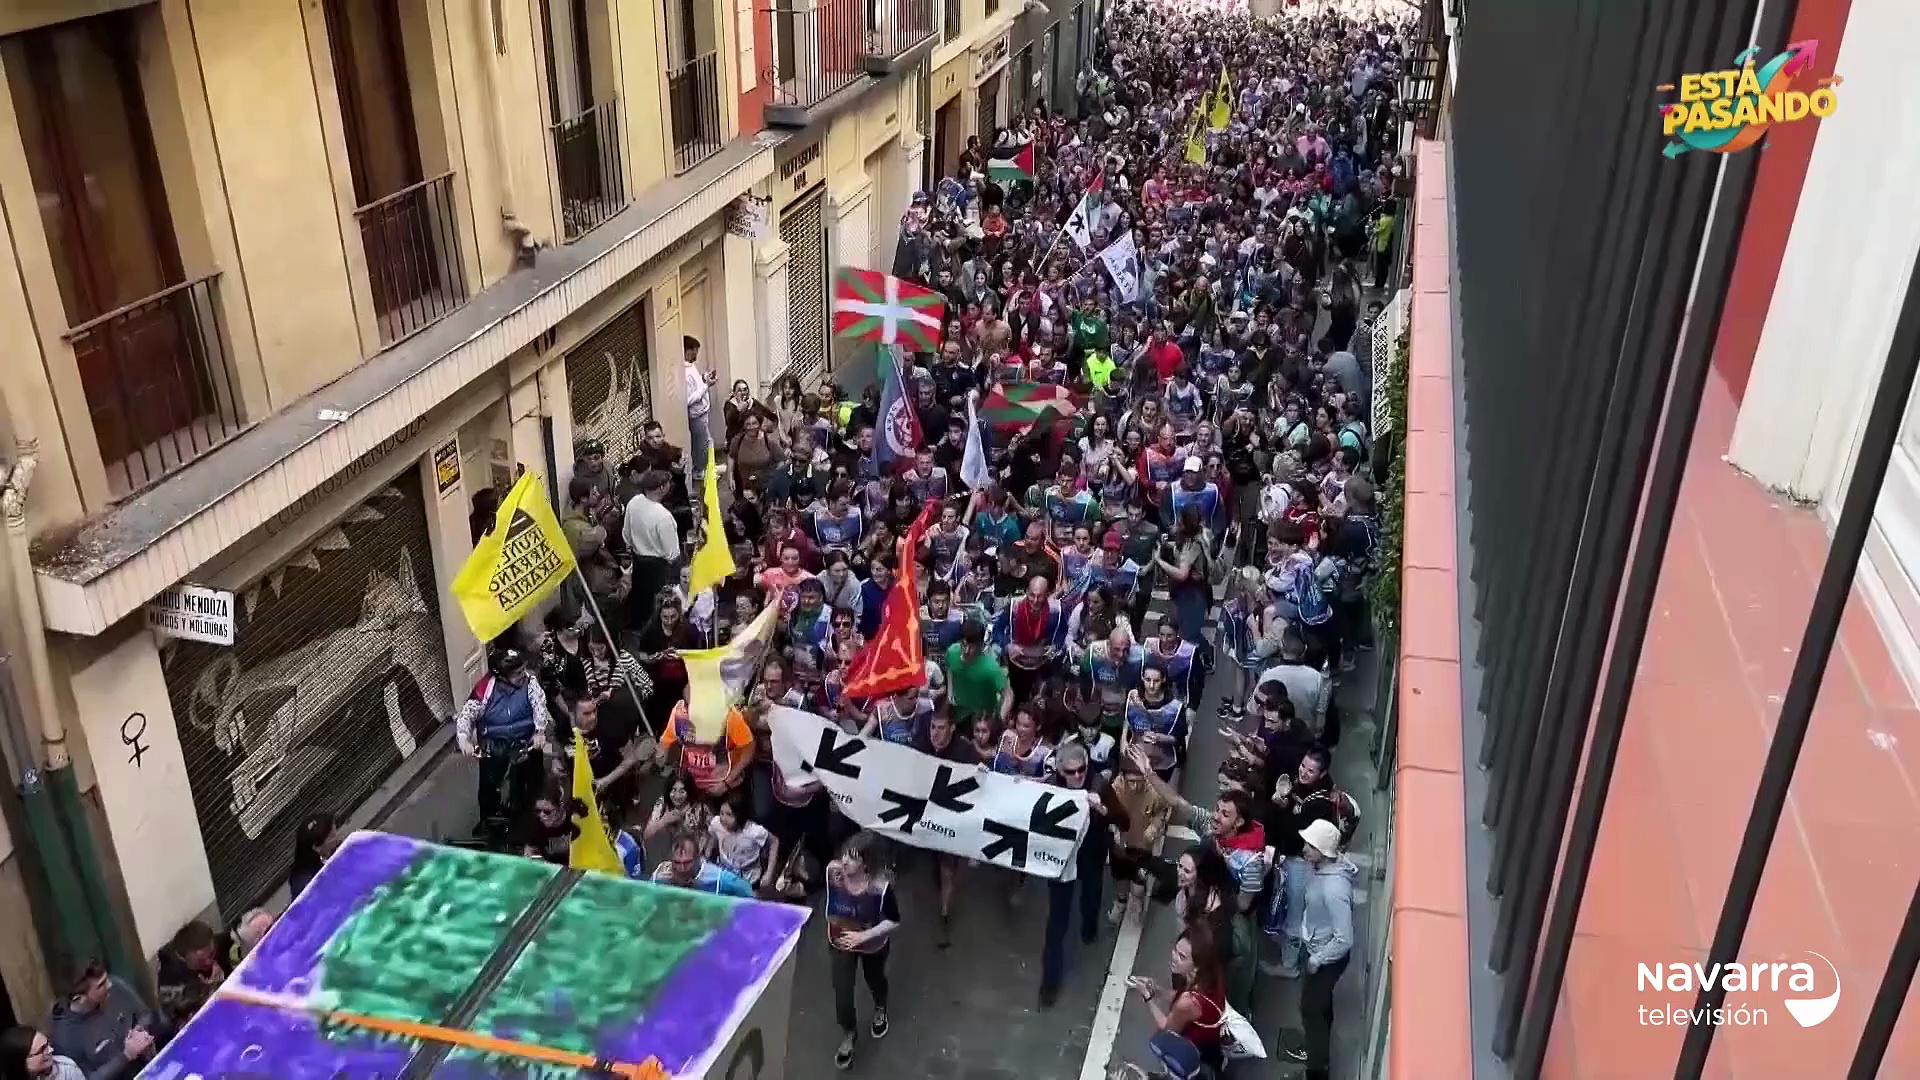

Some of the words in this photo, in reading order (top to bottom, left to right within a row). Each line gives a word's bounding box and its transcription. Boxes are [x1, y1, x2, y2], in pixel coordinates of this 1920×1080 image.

[184, 594, 228, 617] MENDOZA
[182, 618, 187, 632] Y
[189, 619, 228, 638] MOLDURAS
